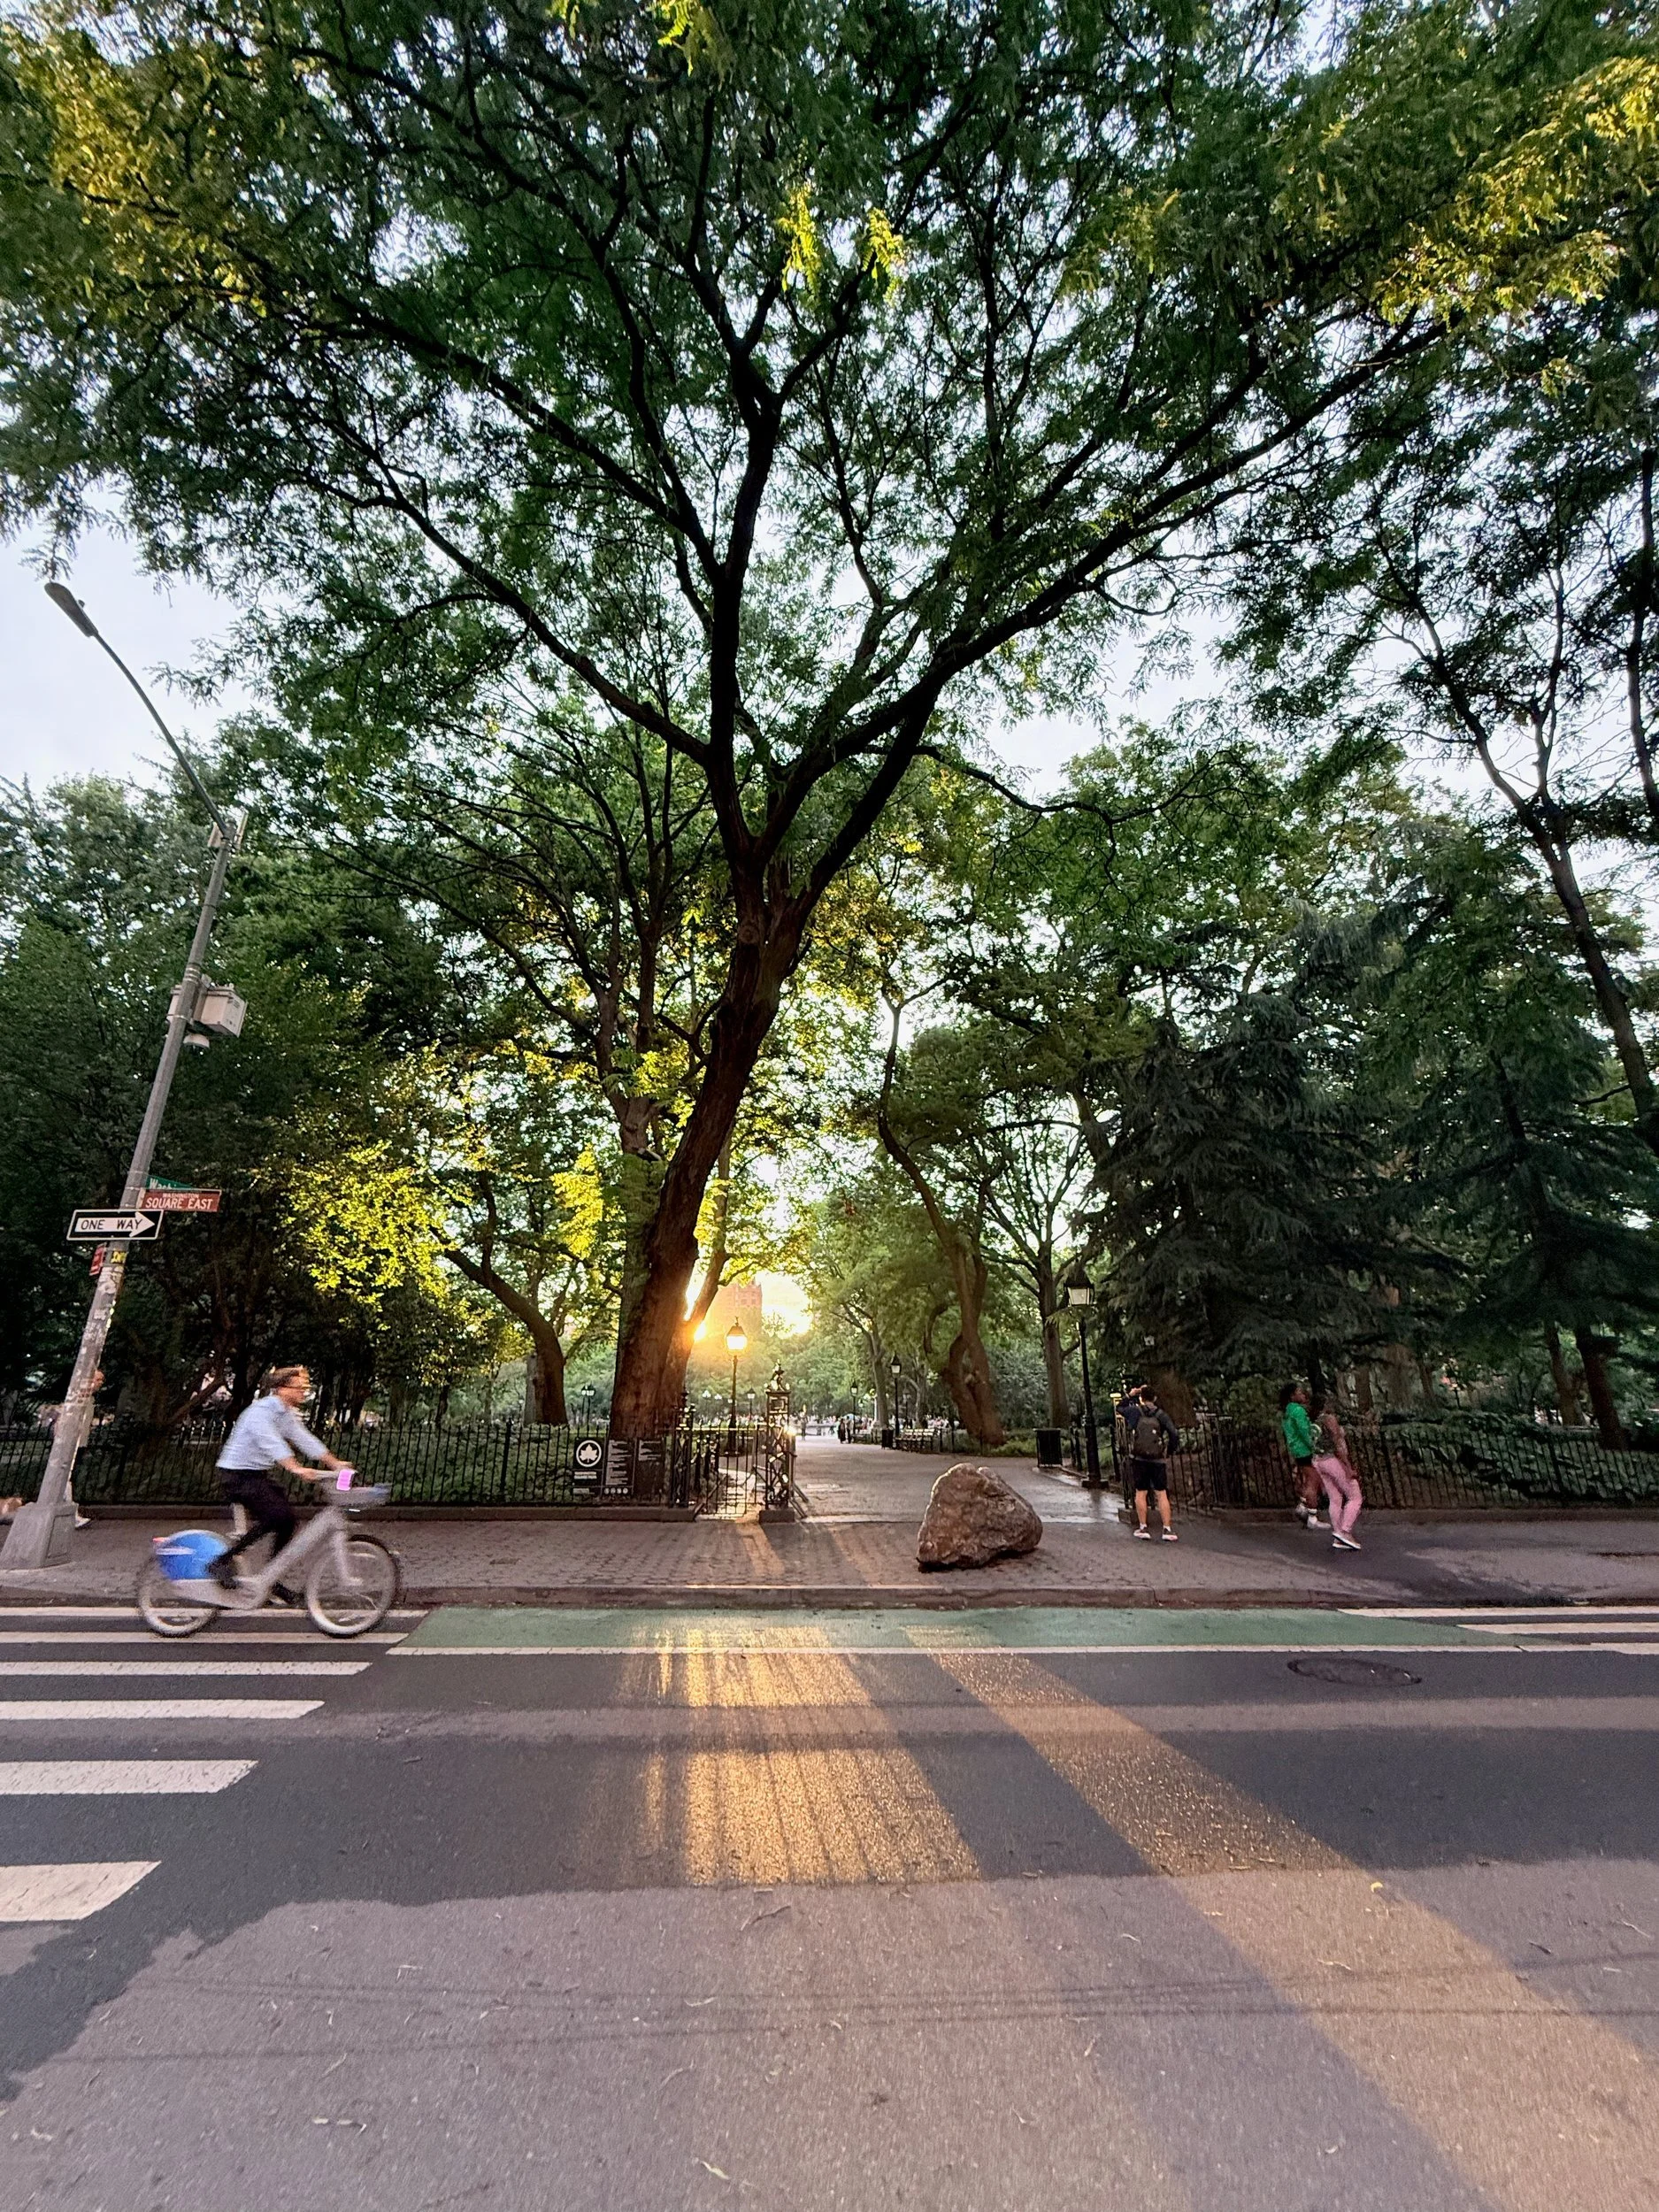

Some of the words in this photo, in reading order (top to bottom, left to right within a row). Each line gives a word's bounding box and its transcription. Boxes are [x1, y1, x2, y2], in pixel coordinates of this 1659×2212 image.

[145, 1197, 185, 1209] SQUARE
[188, 1198, 213, 1210] EAST
[81, 1219, 105, 1230] ONE
[116, 1218, 142, 1230] WAY
